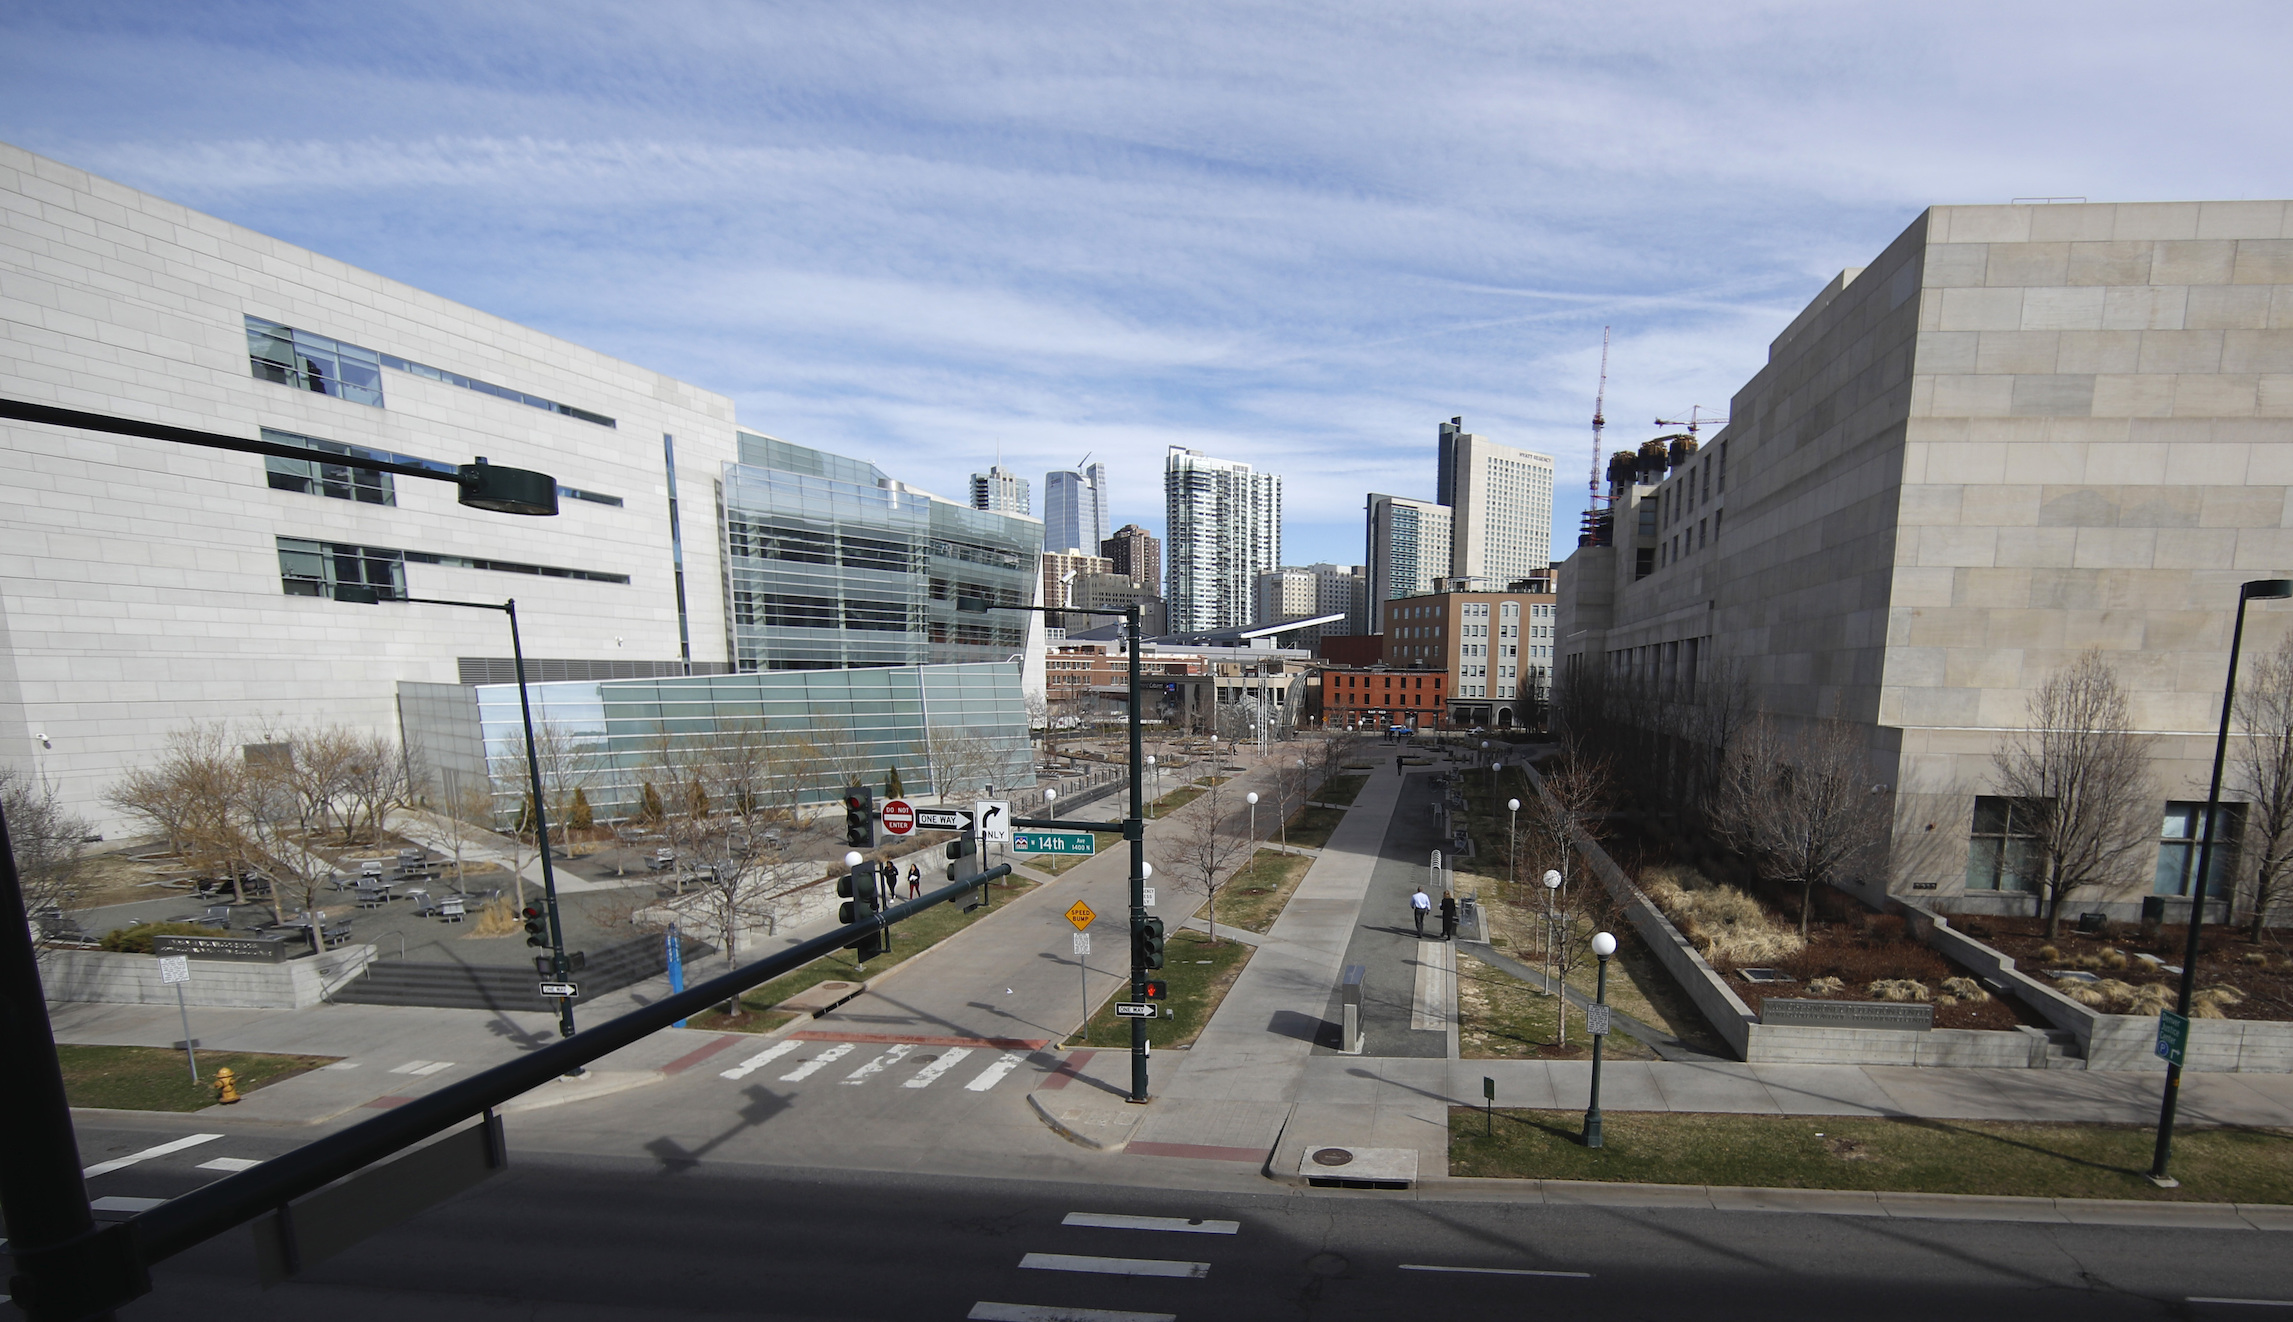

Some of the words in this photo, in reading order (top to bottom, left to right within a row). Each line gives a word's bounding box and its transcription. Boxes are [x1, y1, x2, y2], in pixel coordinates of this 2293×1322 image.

[921, 815, 937, 823] ONE
[940, 816, 957, 824] WAY
[984, 831, 1005, 839] NLY
[1039, 836, 1065, 850] 14th
[2162, 1013, 2180, 1026] Denver
[2161, 1022, 2180, 1037] Justice
[2160, 1031, 2176, 1045] Center
